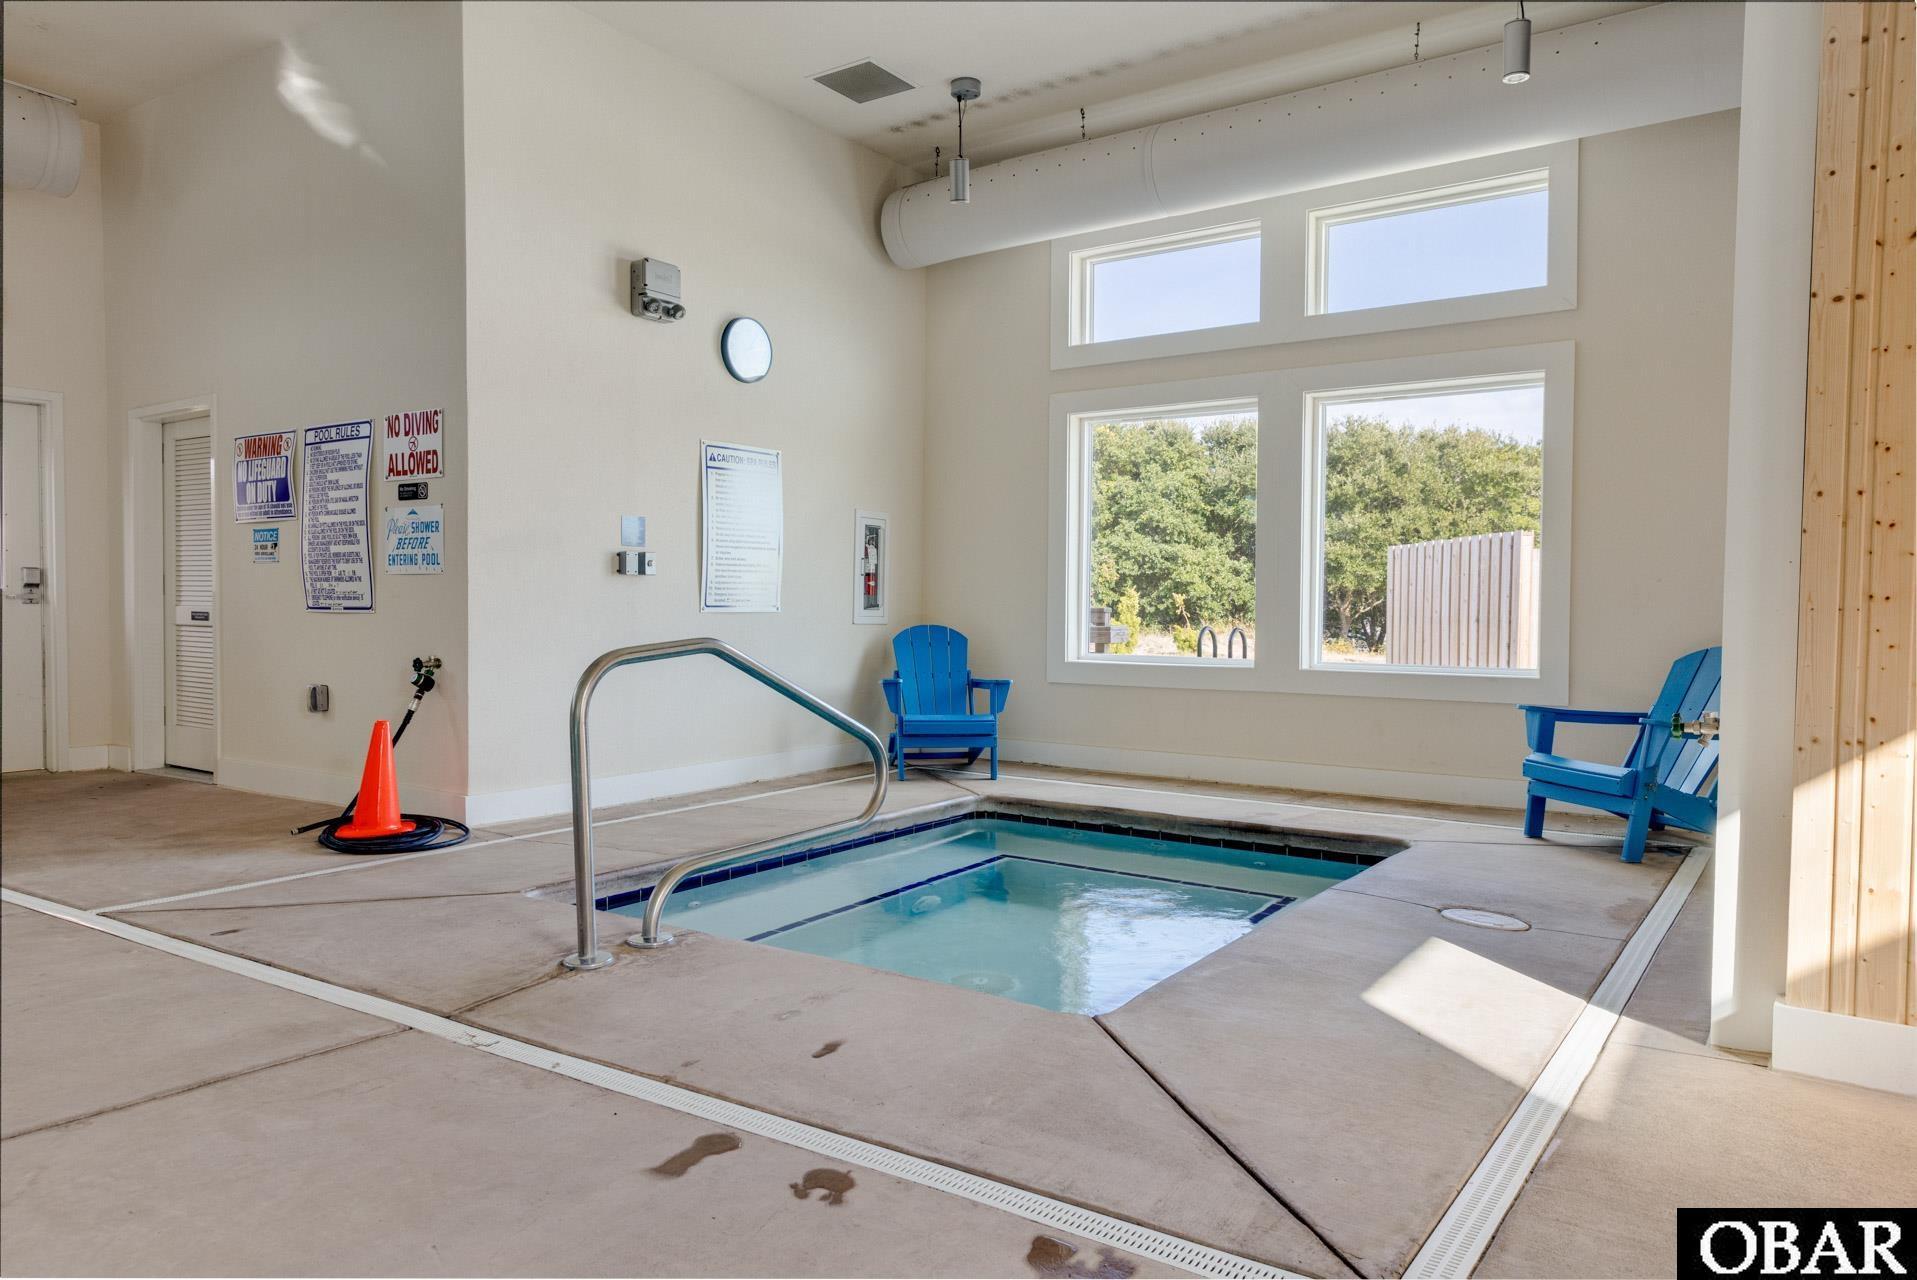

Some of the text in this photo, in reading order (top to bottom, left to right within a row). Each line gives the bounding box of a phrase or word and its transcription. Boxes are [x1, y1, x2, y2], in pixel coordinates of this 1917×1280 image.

[314, 425, 361, 441] POOL RULES
[387, 409, 439, 439] NO DIVING
[244, 434, 283, 459] WARNING
[238, 456, 287, 483] NO LIFEGUARD
[388, 449, 439, 477] ALLOWED
[246, 480, 277, 504] ON DUTY
[254, 530, 278, 541] NOTICE
[411, 521, 440, 534] SHOWER
[395, 536, 431, 550] BEFORE
[388, 553, 440, 566] ENTERING POOL
